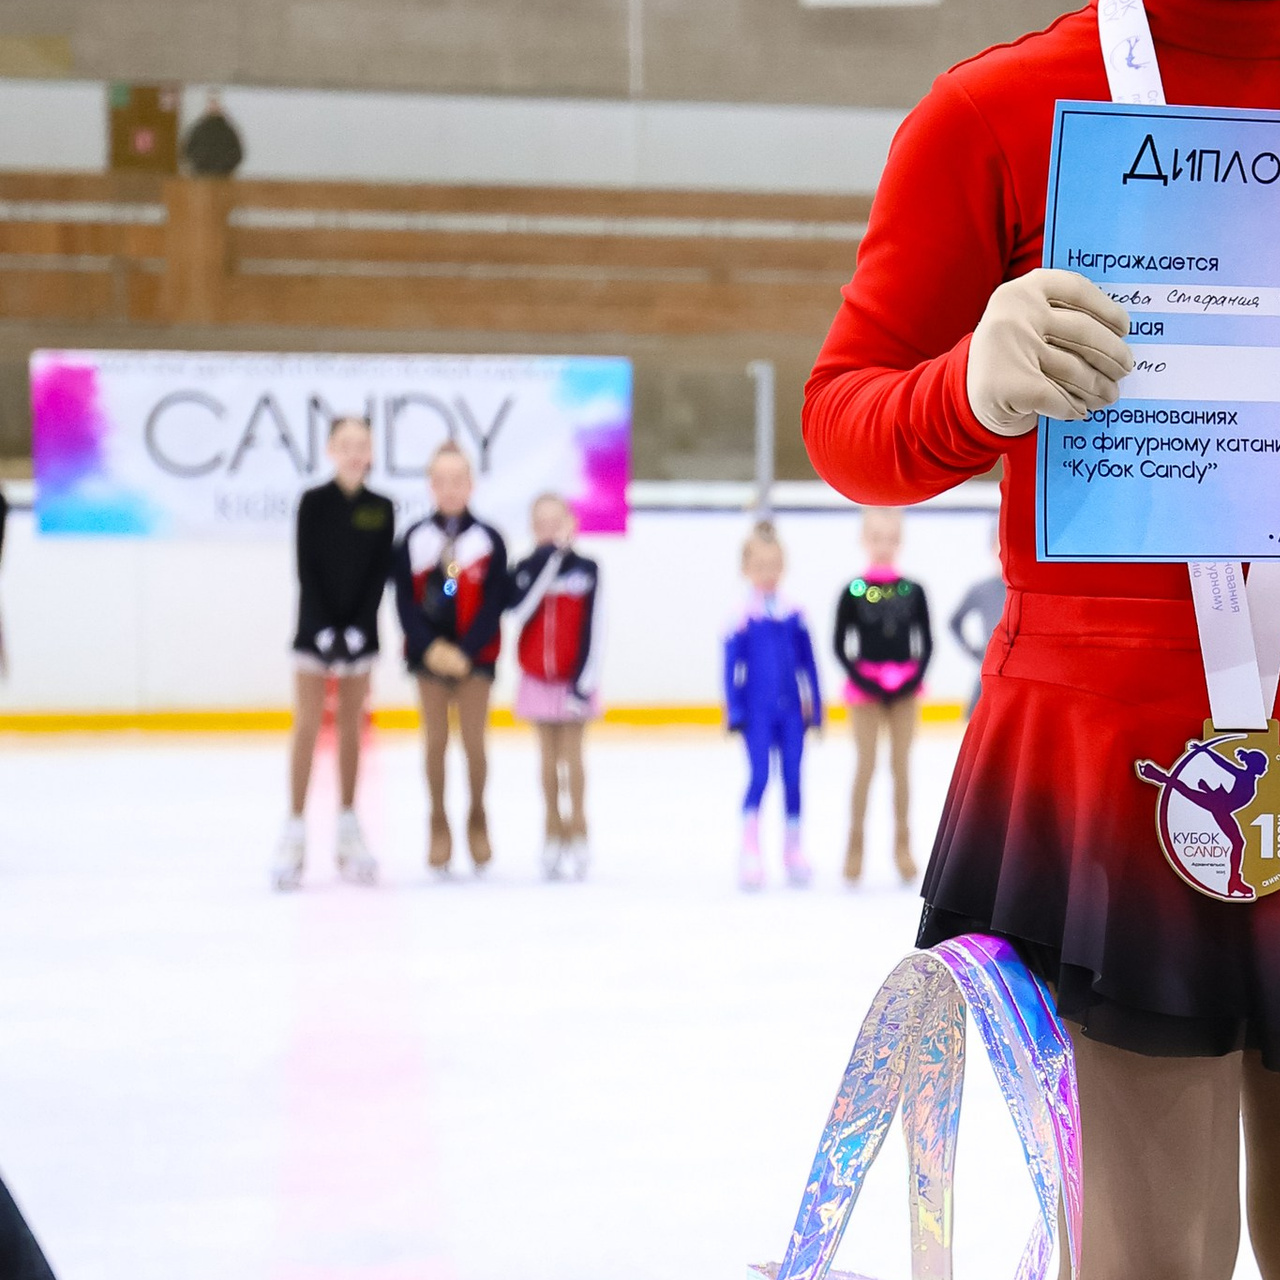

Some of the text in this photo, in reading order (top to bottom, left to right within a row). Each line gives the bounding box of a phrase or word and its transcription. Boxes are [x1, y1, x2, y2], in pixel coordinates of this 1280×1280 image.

[1068, 248, 1219, 273] Награждается
[1063, 436, 1087, 449] по
[1092, 432, 1211, 457] фигурному
[1173, 832, 1220, 844] КУБОК
[1249, 813, 1274, 859] 1
[1183, 845, 1230, 858] CANDY
